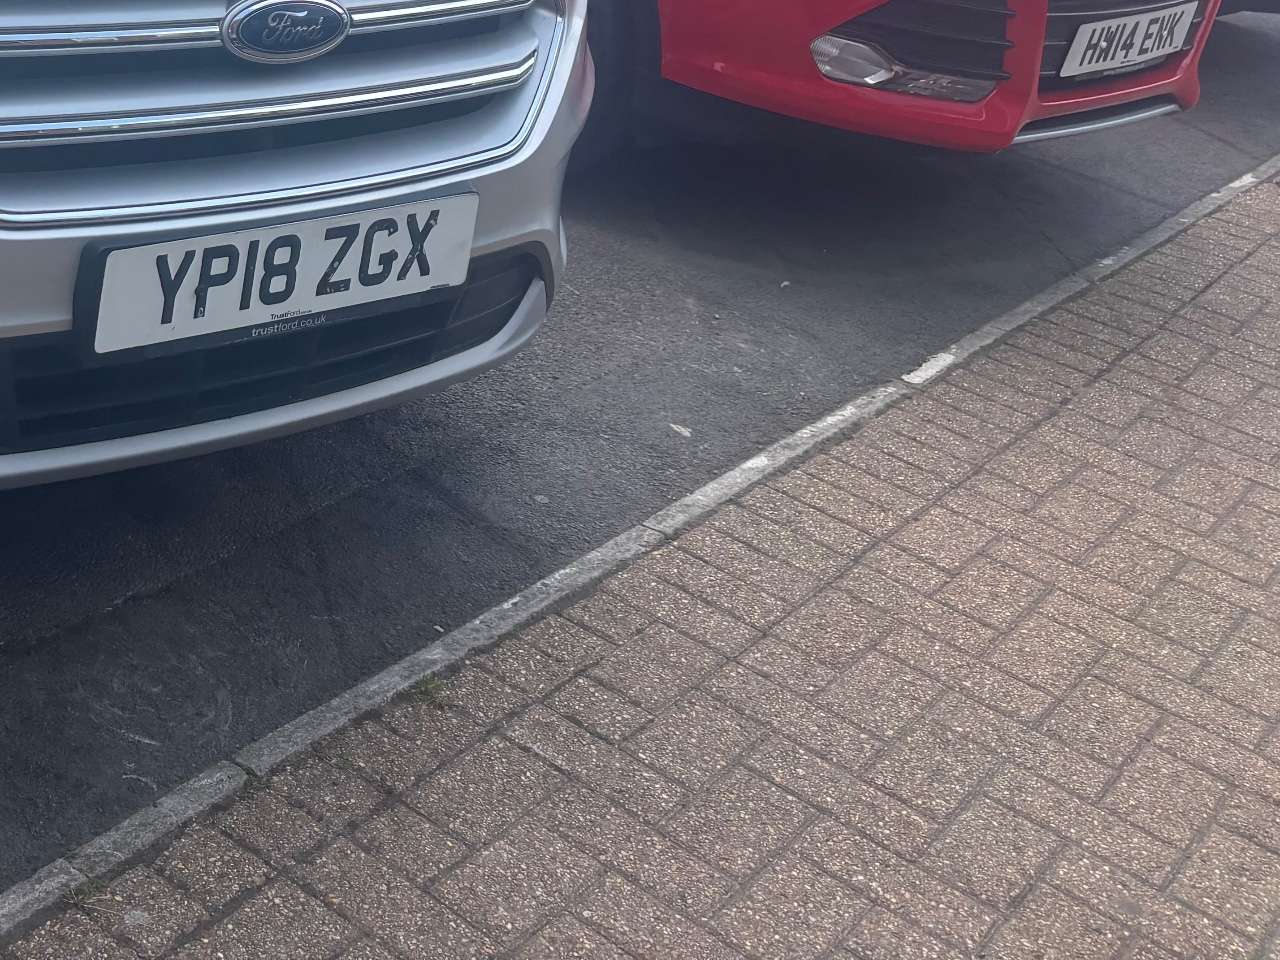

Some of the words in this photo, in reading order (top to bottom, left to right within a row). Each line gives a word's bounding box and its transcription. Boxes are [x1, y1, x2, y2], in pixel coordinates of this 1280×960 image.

[1079, 20, 1141, 67] HW14
[1137, 9, 1185, 57] ENK
[155, 233, 303, 326] YP18
[315, 208, 441, 297] ZGX
[251, 313, 328, 337] trustford.co.uk
